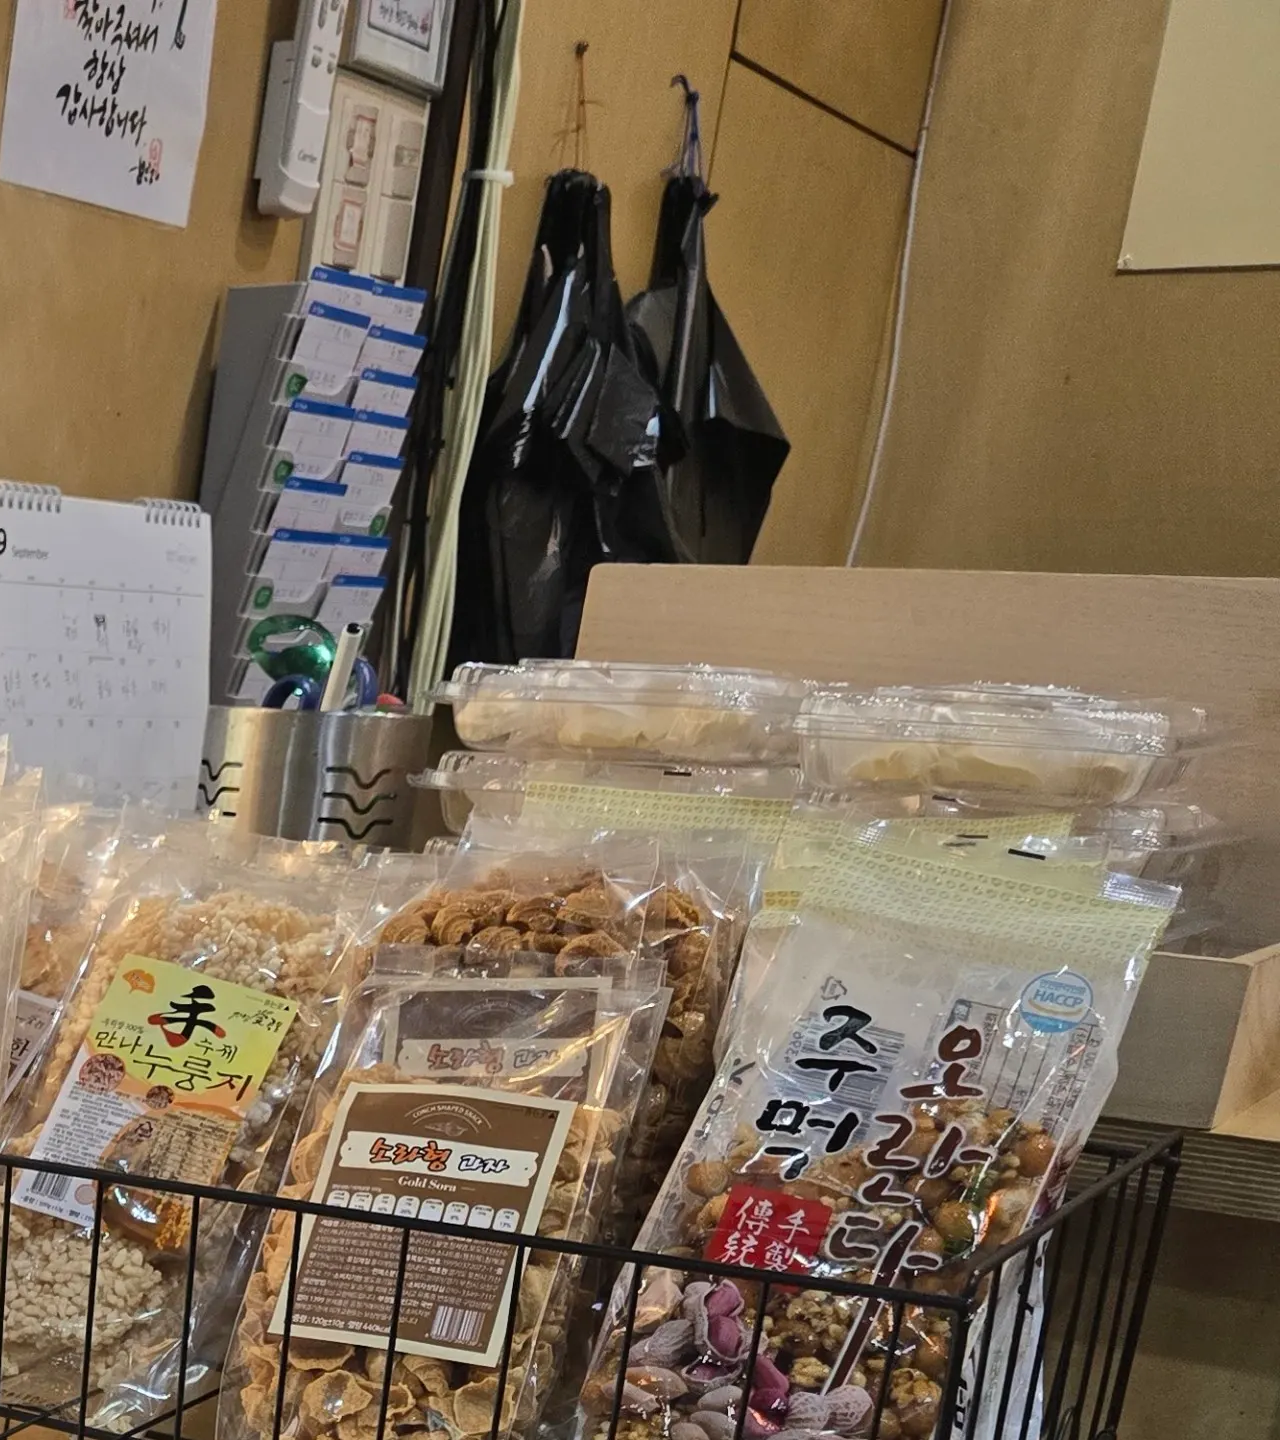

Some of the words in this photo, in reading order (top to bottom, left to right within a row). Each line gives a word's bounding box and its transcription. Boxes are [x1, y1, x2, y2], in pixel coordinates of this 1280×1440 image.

[1032, 988, 1086, 1009] HACCP
[133, 1044, 253, 1102] 누룽지
[756, 1004, 878, 1180] 주먹
[436, 1103, 465, 1115] SHAPED
[463, 1107, 484, 1127] SNACK
[369, 1137, 453, 1172] 소라형
[457, 1154, 510, 1174] 과자
[397, 1174, 428, 1188] Gold
